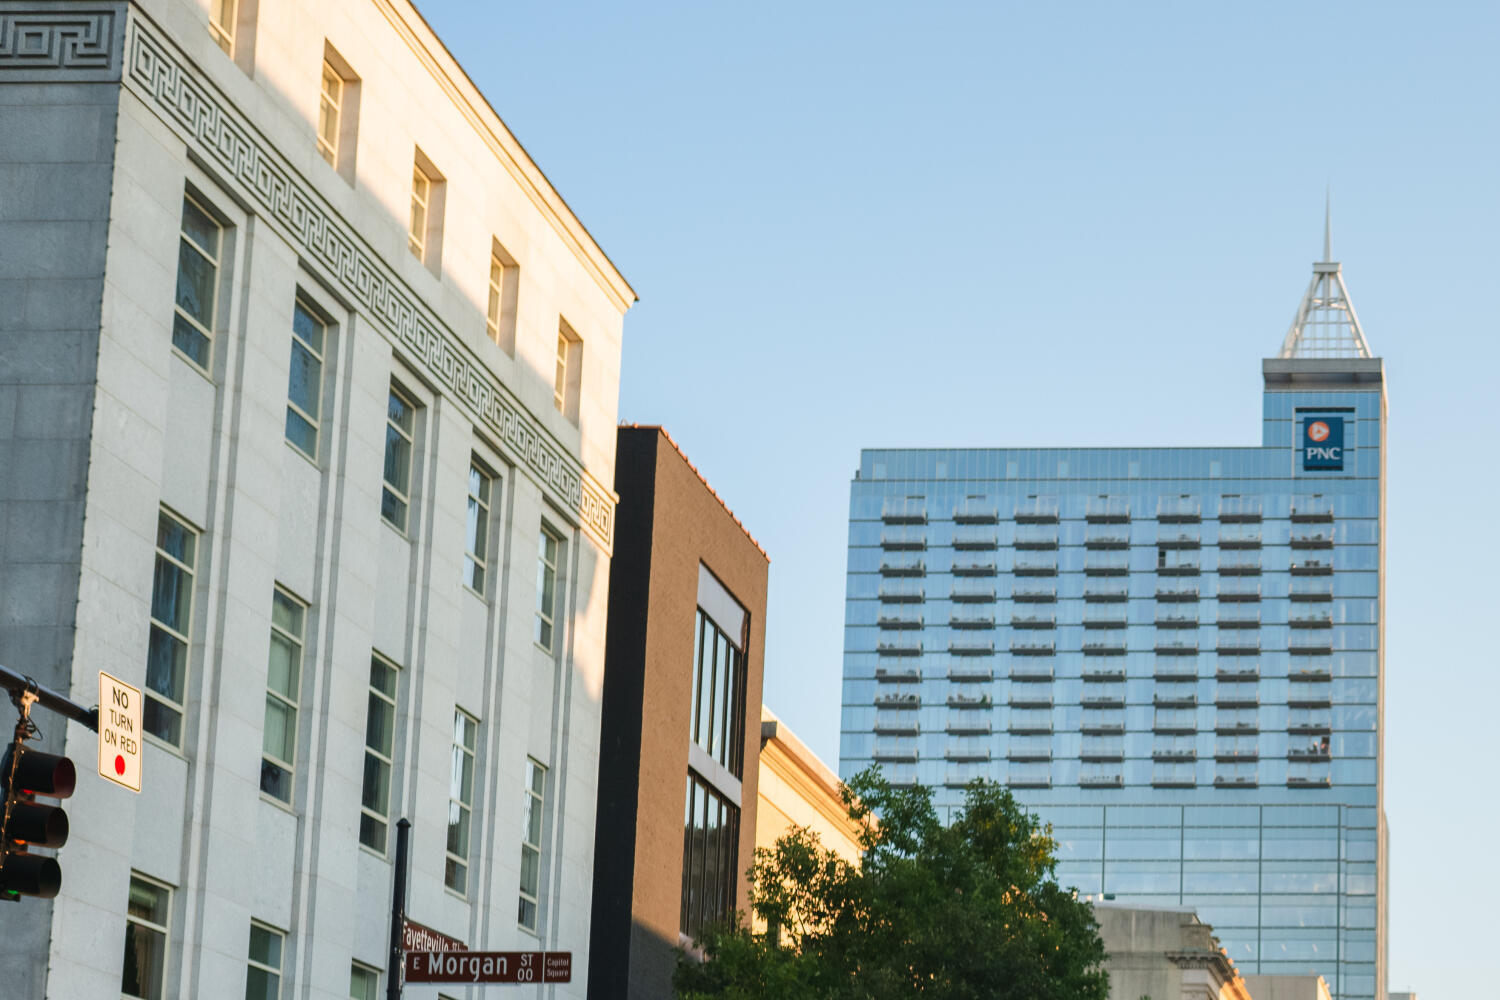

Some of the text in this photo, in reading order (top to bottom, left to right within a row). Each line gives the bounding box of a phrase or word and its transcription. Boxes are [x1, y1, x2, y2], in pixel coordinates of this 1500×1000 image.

[1306, 447, 1341, 460] PNC
[112, 686, 128, 709] NO
[110, 708, 133, 733] TURN
[105, 728, 137, 755] ON RED
[413, 952, 534, 982] E Morgan ST
[547, 958, 569, 968] Capitol
[517, 968, 533, 981] 00
[546, 968, 569, 978] Square
